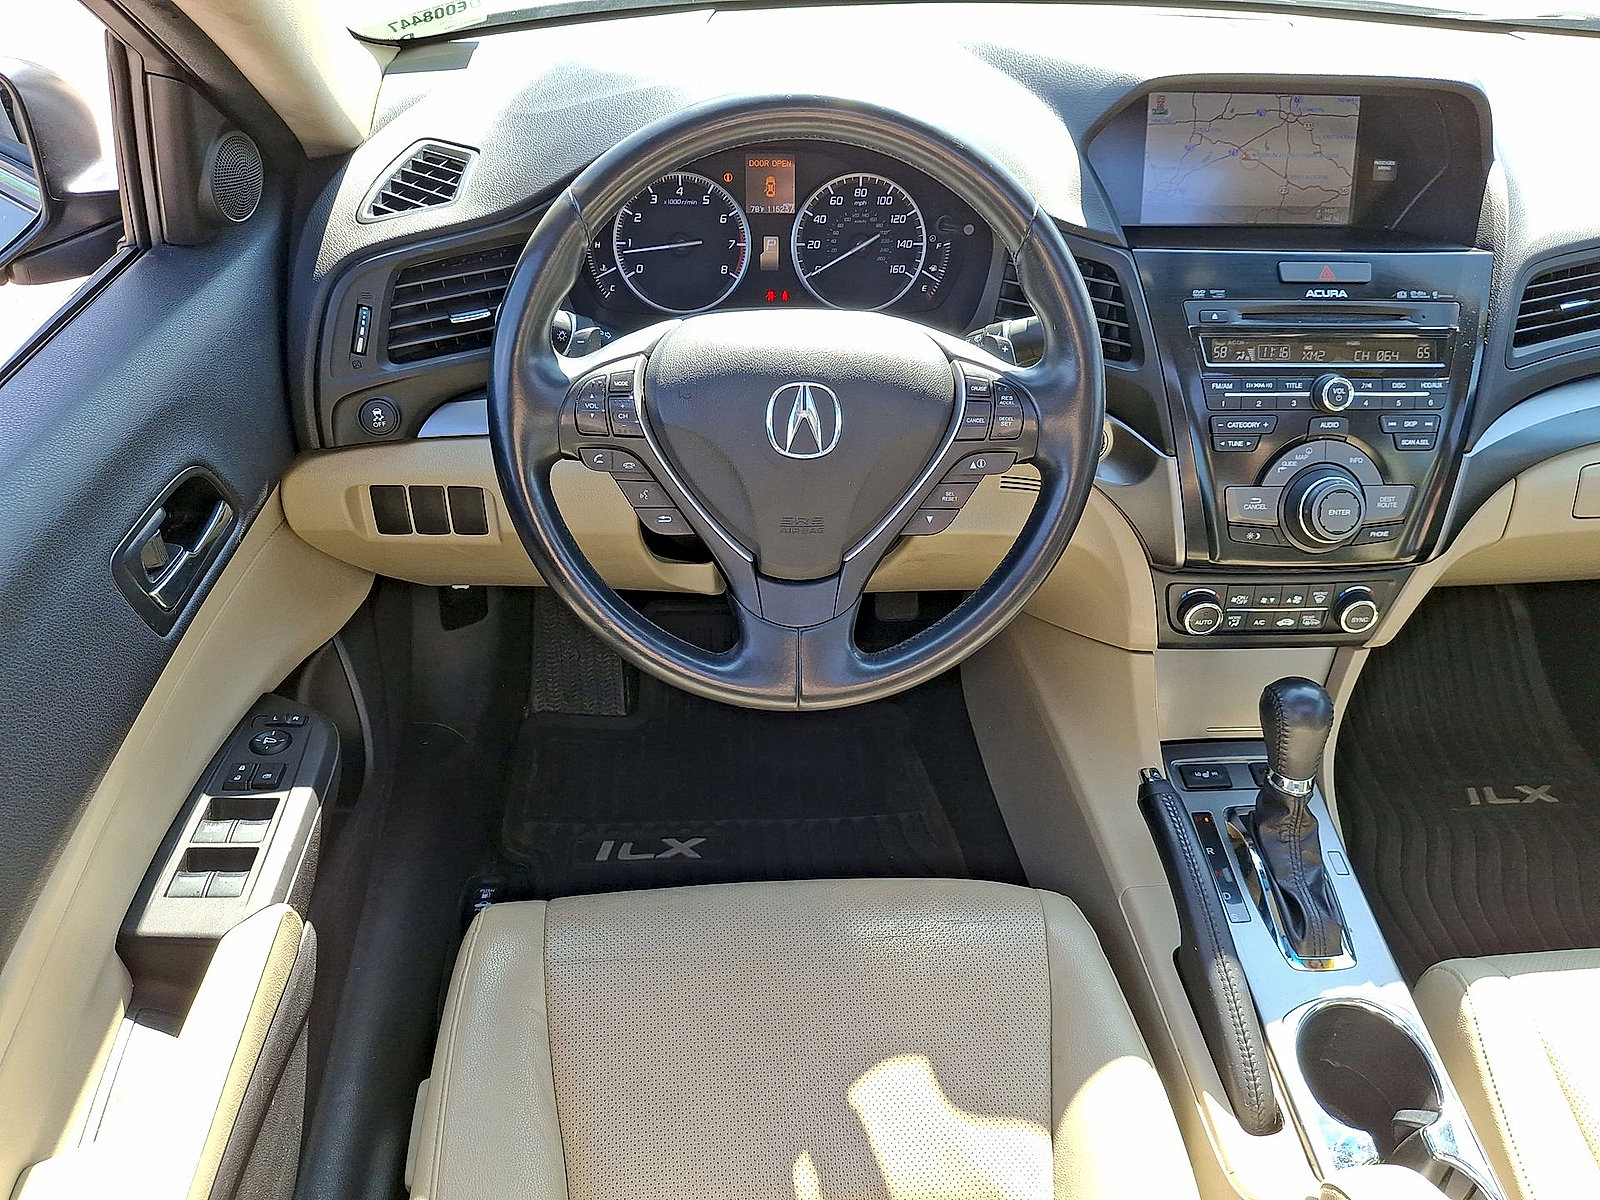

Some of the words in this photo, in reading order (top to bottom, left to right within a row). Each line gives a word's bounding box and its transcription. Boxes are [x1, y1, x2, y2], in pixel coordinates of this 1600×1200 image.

[748, 159, 770, 168] DOOR
[771, 159, 792, 168] OPEN
[675, 187, 684, 197] 4
[853, 188, 868, 198] 80
[650, 195, 658, 204] 3
[702, 195, 710, 205] 5
[829, 197, 844, 206] 60
[876, 197, 894, 206] 100
[633, 213, 642, 223] 2
[719, 214, 728, 224] 6
[812, 214, 827, 224] 40
[890, 214, 907, 224] 120
[594, 241, 601, 249] H
[627, 238, 632, 247] 1
[728, 240, 735, 250] 7
[767, 239, 777, 249] P
[807, 240, 821, 249] 20
[896, 240, 913, 249] 140
[935, 242, 943, 250] F
[635, 264, 644, 274] 0
[720, 265, 729, 275] 8
[889, 265, 906, 274] 160
[609, 283, 616, 292] C
[921, 284, 928, 292] E
[1305, 289, 1349, 298] ACURA
[1213, 346, 1228, 359] 58
[1262, 346, 1289, 358] 11:16
[1302, 350, 1326, 361] XM2
[1354, 350, 1370, 361] CH
[1376, 350, 1400, 361] 064
[1416, 346, 1430, 359] 65
[584, 402, 599, 410] VOL
[618, 412, 629, 420] CH
[1227, 421, 1261, 429] CATEGORY
[1319, 421, 1340, 429] AUDIO
[1403, 420, 1418, 428] SKIP
[1228, 440, 1244, 448] TUNE
[1377, 501, 1398, 509] ROUTE
[1328, 509, 1351, 517] ENTER
[1194, 618, 1213, 626] AUTO
[1350, 616, 1370, 624] SYNC
[1466, 785, 1559, 806] ILX
[595, 837, 707, 861] ILX
[1205, 847, 1215, 855] R
[1222, 892, 1232, 901] D
[1231, 913, 1239, 921] S
